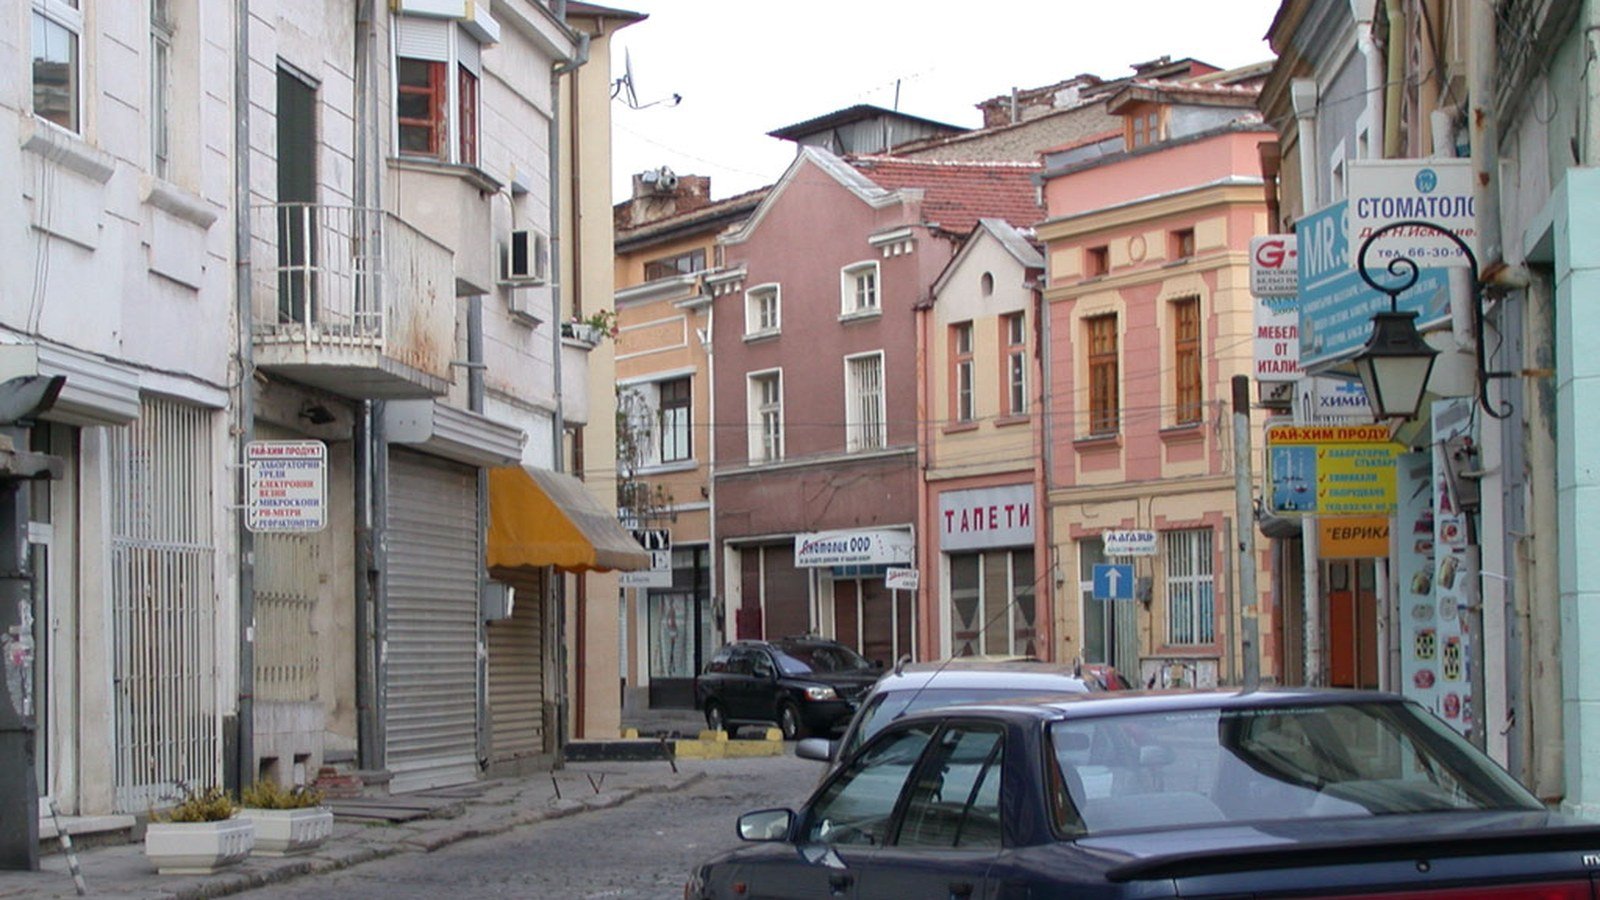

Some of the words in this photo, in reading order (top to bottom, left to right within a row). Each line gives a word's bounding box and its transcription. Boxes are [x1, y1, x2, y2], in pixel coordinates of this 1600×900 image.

[1408, 247, 1465, 257] 66-30-9
[1258, 325, 1299, 339] МЕБЕЛ
[1274, 343, 1288, 356] ОТ
[1258, 359, 1304, 373] ИТАЛИ
[1320, 396, 1370, 408] ХИМИ
[1270, 428, 1334, 440] РАЙ-ХИМ
[250, 445, 283, 455] РАЙ-ХИМ
[285, 446, 320, 456] ПРОДУКТ
[259, 499, 320, 507] МИКРОСКОПИ
[944, 502, 1030, 534] ТАПЕТИ
